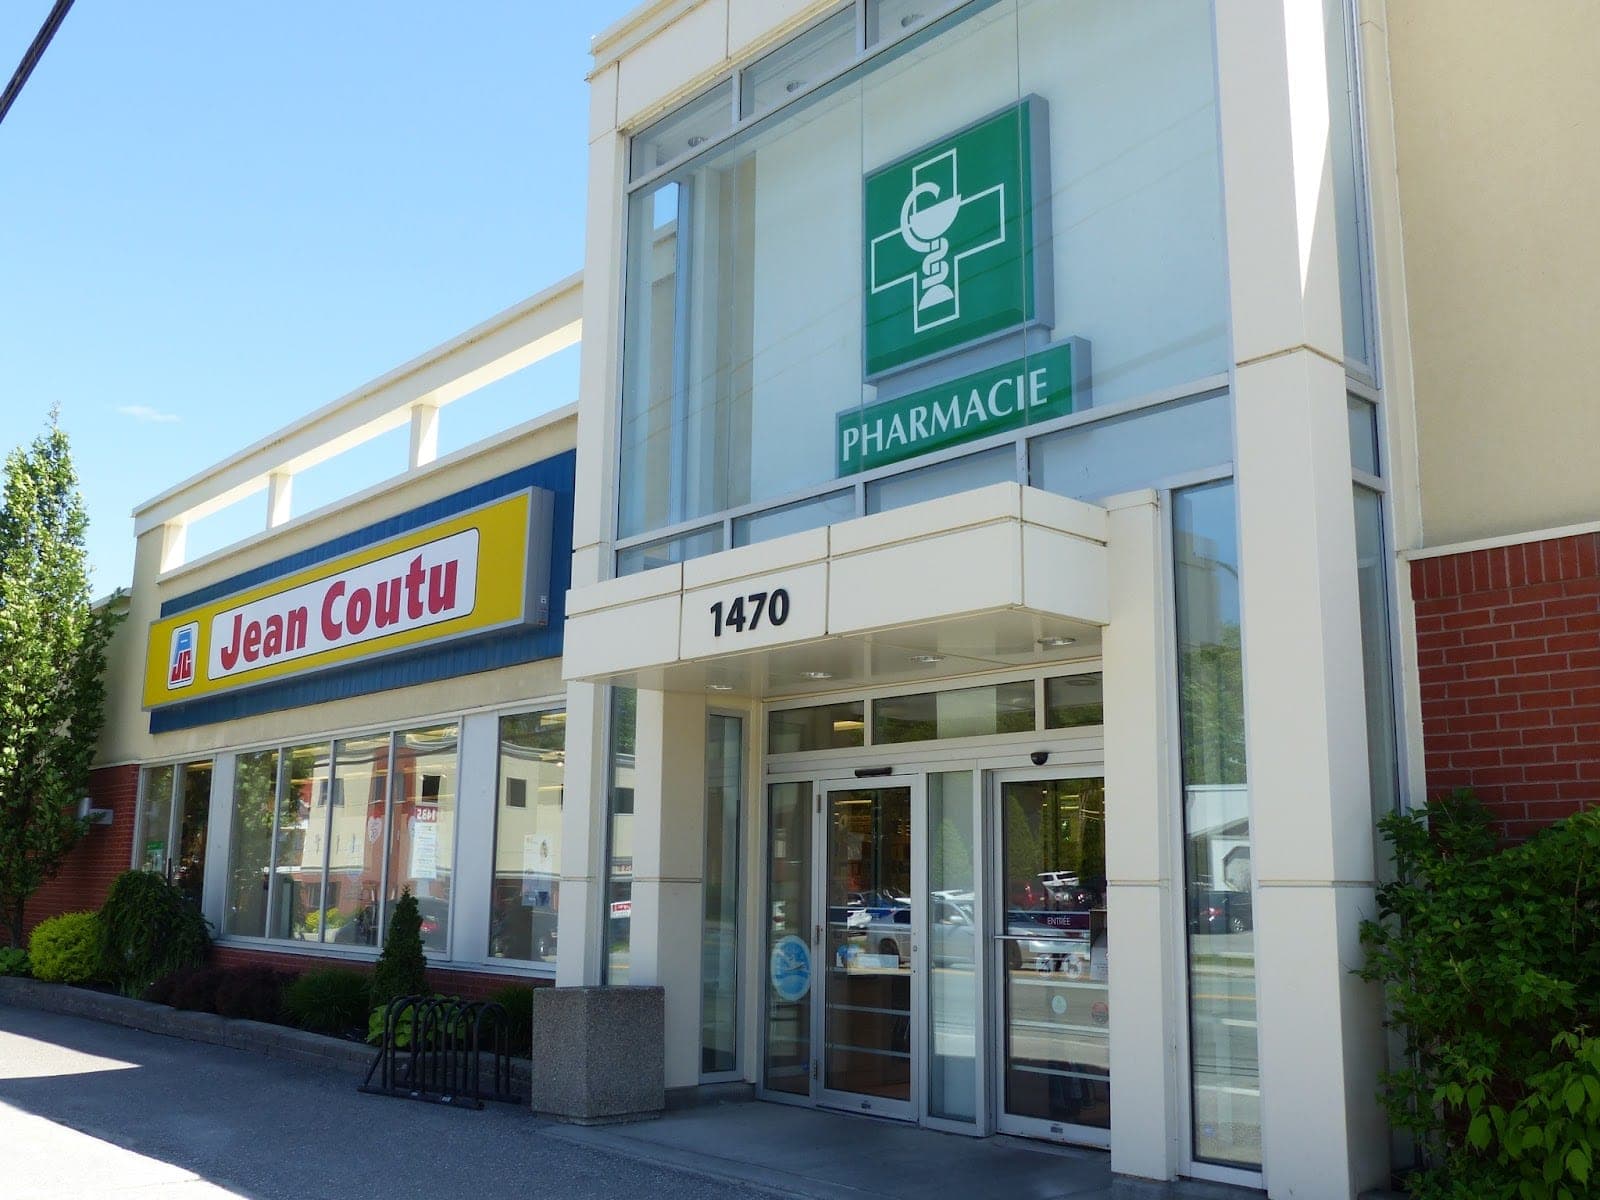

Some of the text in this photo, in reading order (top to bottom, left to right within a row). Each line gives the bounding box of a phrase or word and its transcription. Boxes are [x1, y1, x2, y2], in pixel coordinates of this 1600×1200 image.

[842, 367, 1048, 462] PHARMACIE
[220, 553, 459, 671] Jean Coutu
[710, 588, 790, 637] 1470
[1047, 915, 1072, 926] ENTRÉE
